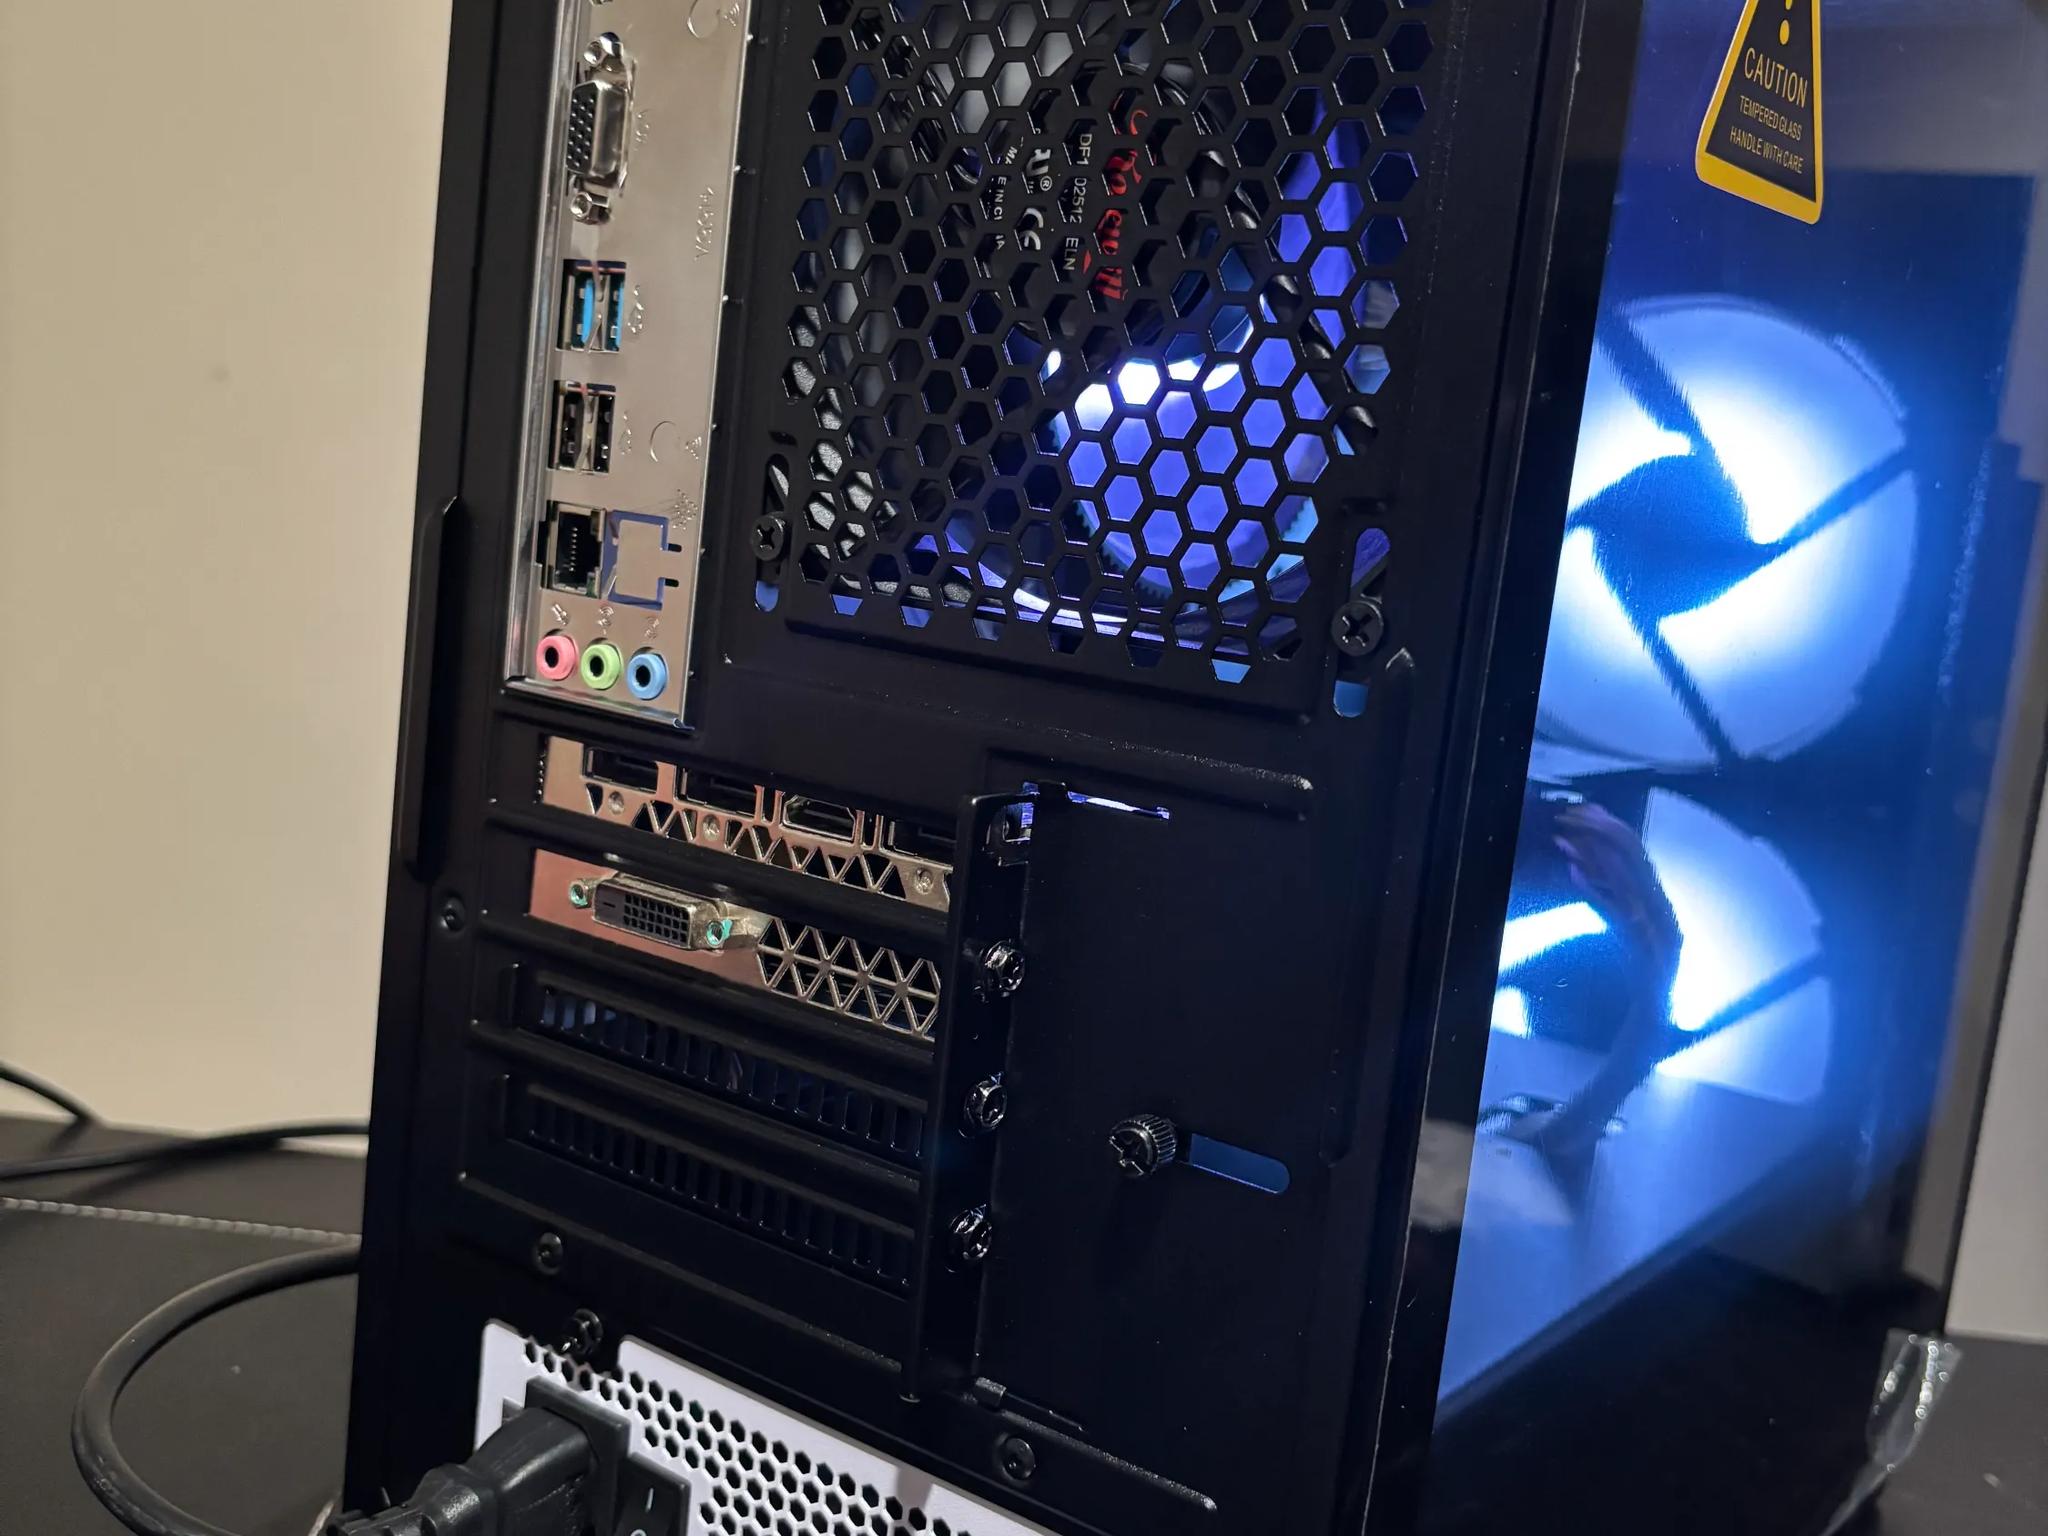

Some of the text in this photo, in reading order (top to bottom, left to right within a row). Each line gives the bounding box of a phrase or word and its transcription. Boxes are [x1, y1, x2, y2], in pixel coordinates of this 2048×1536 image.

[1745, 47, 1807, 108] CAUTION
[1740, 94, 1802, 141] TEMPERED GLASS
[1730, 125, 1803, 174] HANDLE WITH CARE
